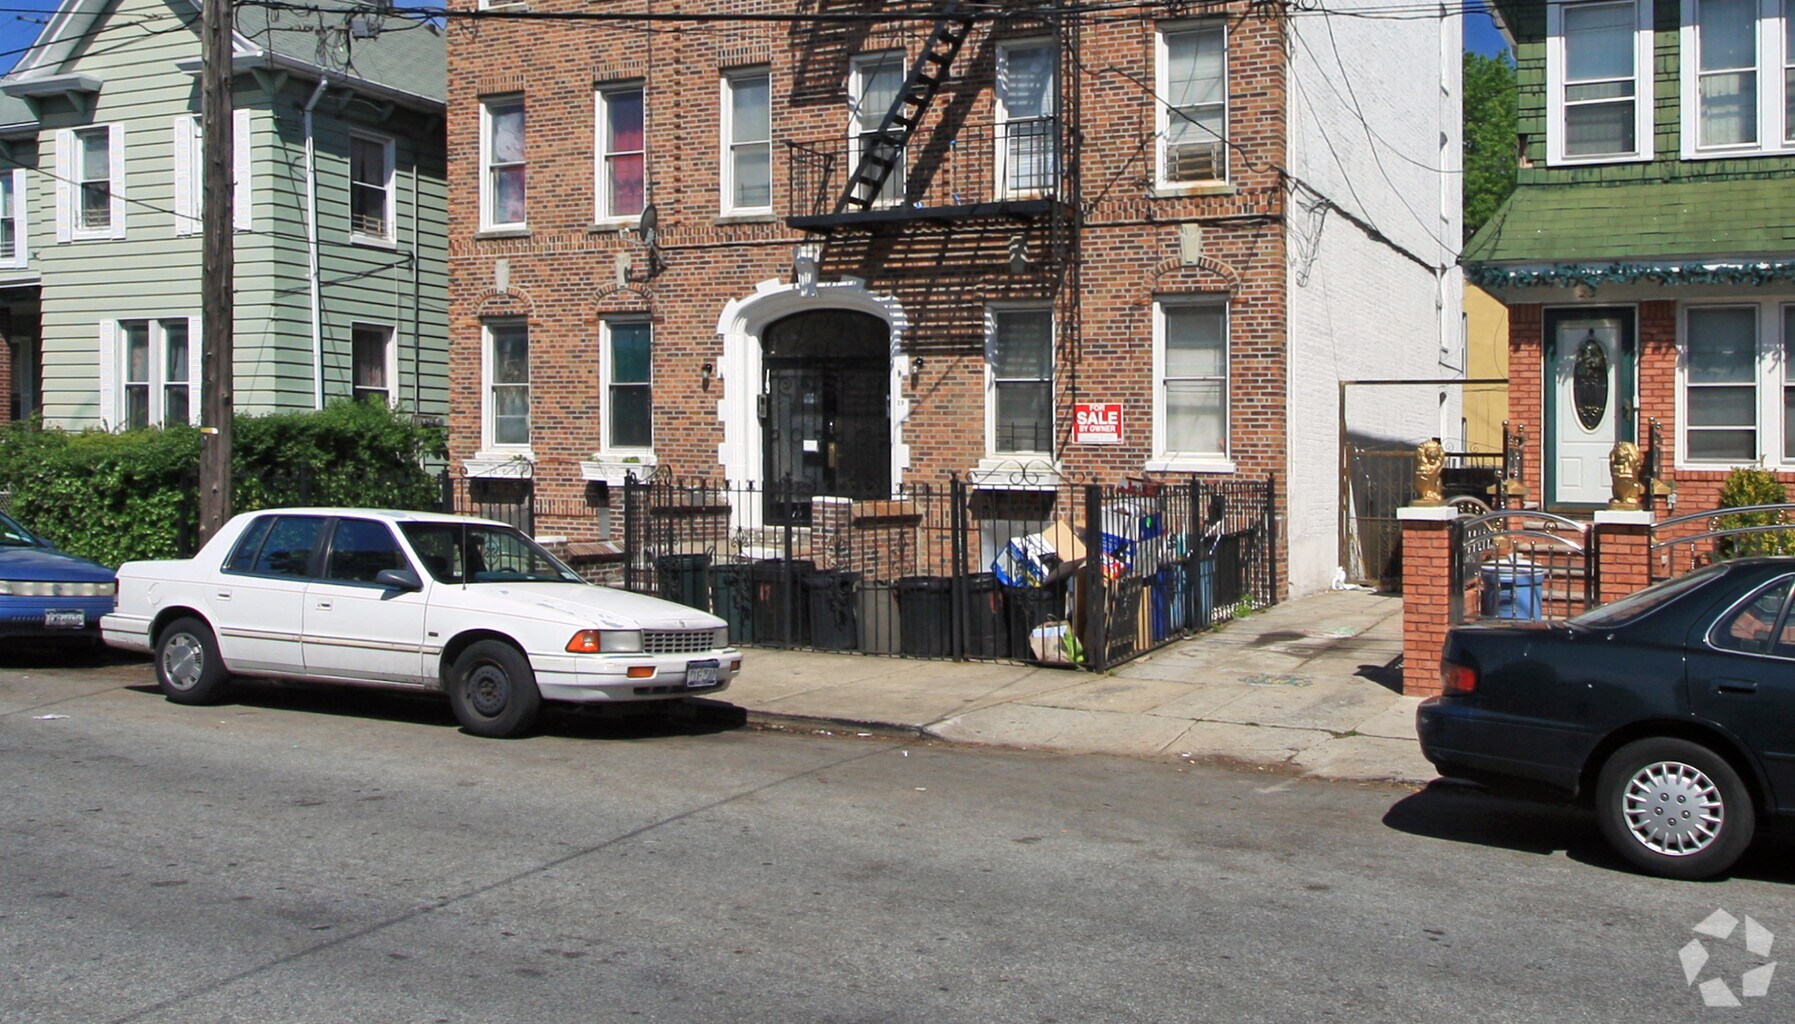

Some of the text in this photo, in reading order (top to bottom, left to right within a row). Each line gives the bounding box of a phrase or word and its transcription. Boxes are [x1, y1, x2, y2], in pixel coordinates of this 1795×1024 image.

[1089, 403, 1105, 411] FOR
[1076, 411, 1118, 425] SALE
[1079, 424, 1116, 432] BY OWNER
